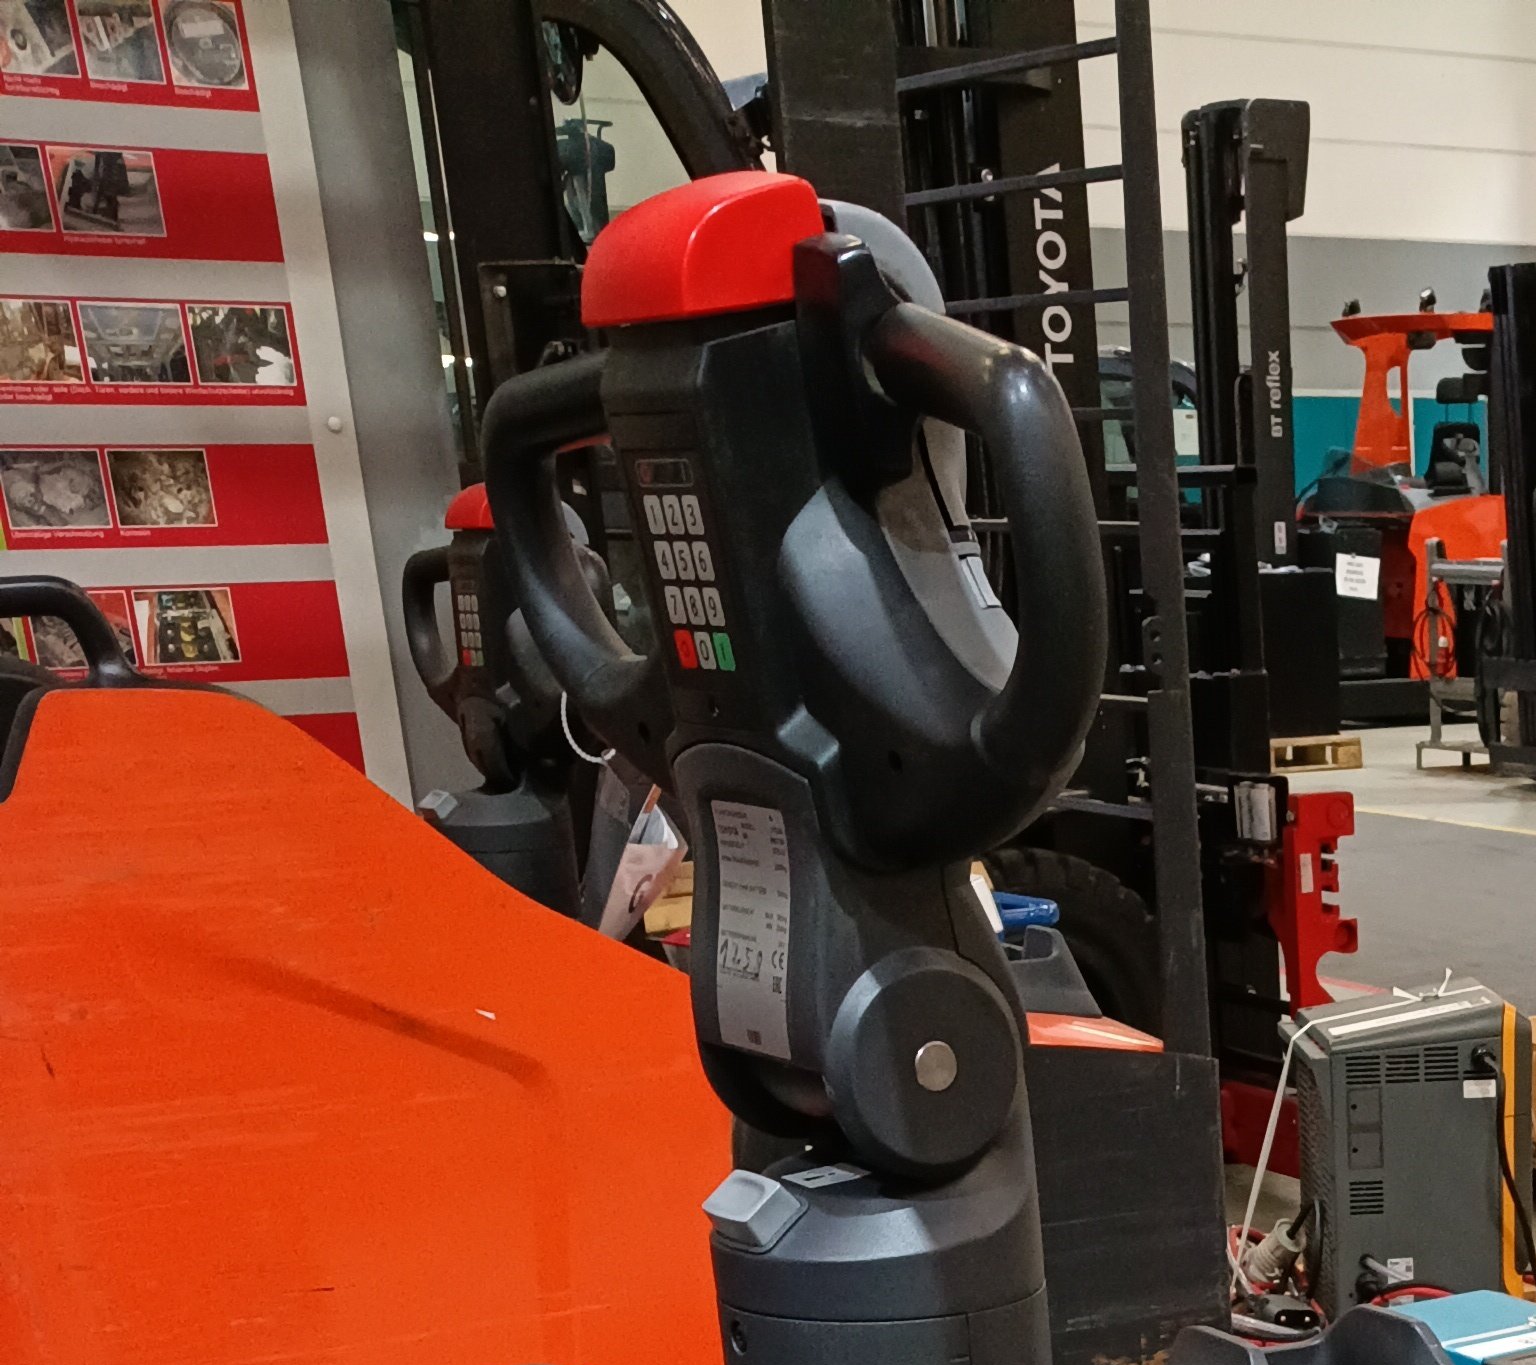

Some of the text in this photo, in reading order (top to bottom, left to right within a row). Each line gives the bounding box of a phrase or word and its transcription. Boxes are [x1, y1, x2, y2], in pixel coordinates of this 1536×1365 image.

[1033, 163, 1075, 373] TOYOTA
[1266, 350, 1283, 438] BT reflex
